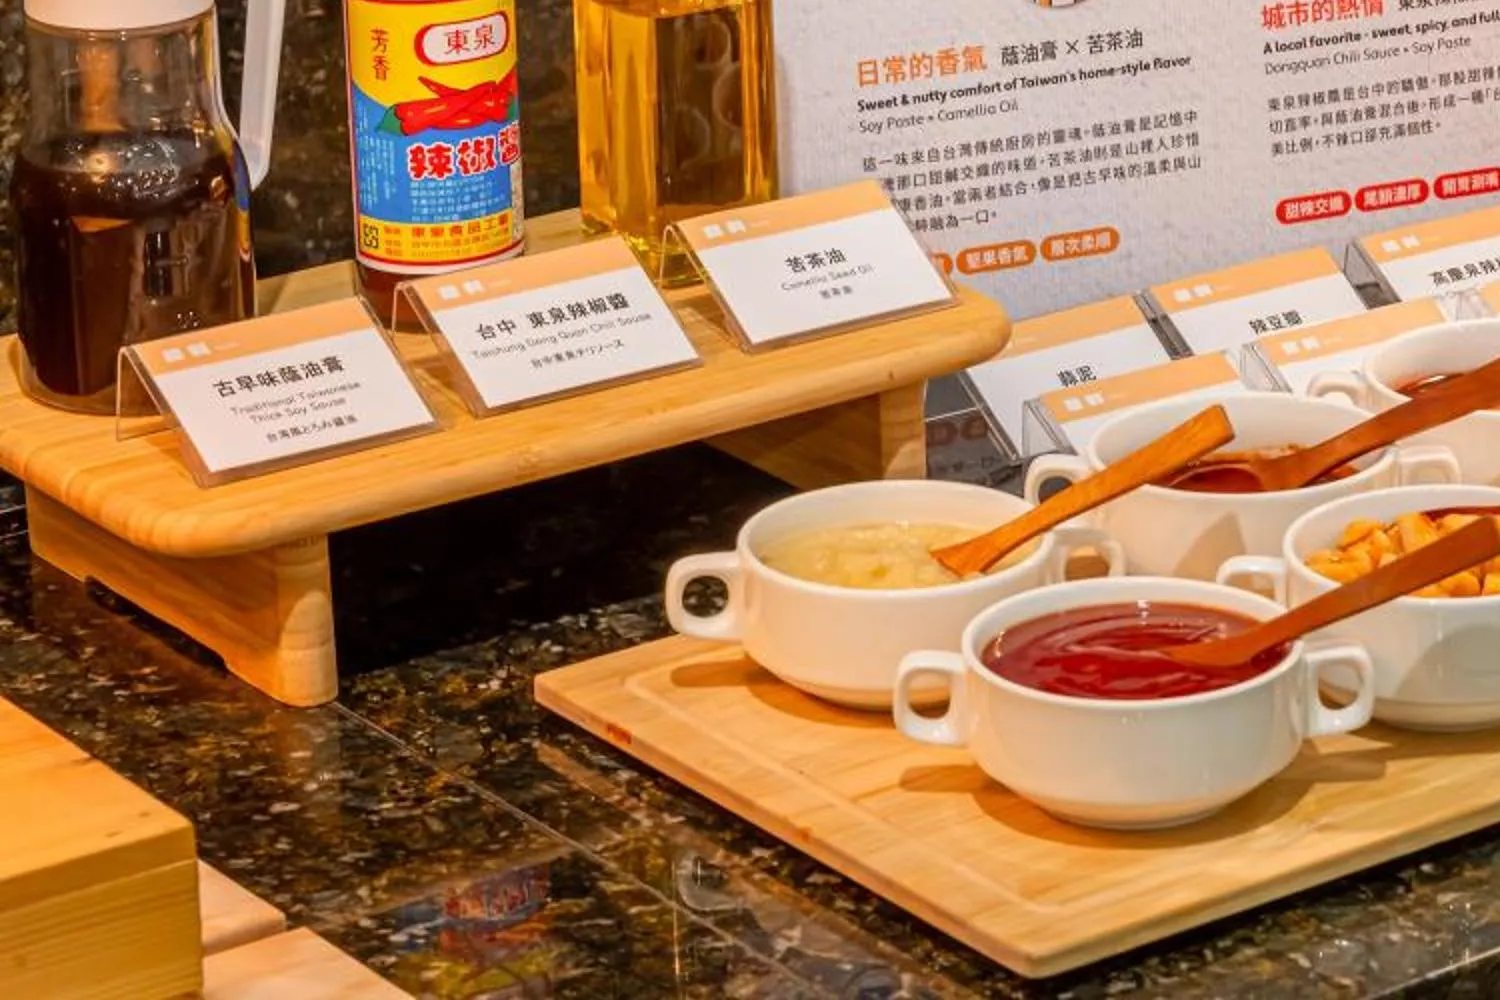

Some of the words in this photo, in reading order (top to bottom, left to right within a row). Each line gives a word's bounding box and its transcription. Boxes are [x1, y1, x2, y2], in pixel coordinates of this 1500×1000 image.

[443, 24, 496, 55] 東泉
[1263, 42, 1273, 54] A
[1275, 39, 1307, 52] local
[1310, 31, 1361, 47] favorite
[1452, 14, 1477, 27] and
[1479, 10, 1500, 24] full
[1363, 46, 1399, 60] Sauce
[1411, 41, 1435, 54] Soy
[1437, 35, 1472, 50] Paste
[857, 46, 988, 87] 日常的香氣
[1087, 29, 1144, 54] 苦茶油
[857, 98, 898, 113] Sweet
[901, 94, 910, 106] &
[913, 88, 946, 105] nutty
[949, 82, 1001, 99] comfort
[1004, 77, 1019, 91] of
[1153, 55, 1192, 71] flavor
[858, 118, 884, 134] Soy
[887, 114, 925, 129] Paste
[937, 103, 997, 121] Camellia
[785, 247, 847, 273] 苦茶油
[476, 317, 517, 341] 台中
[526, 292, 632, 329] 東泉辣椒醬
[212, 355, 346, 397] 古早味蔭油膏
